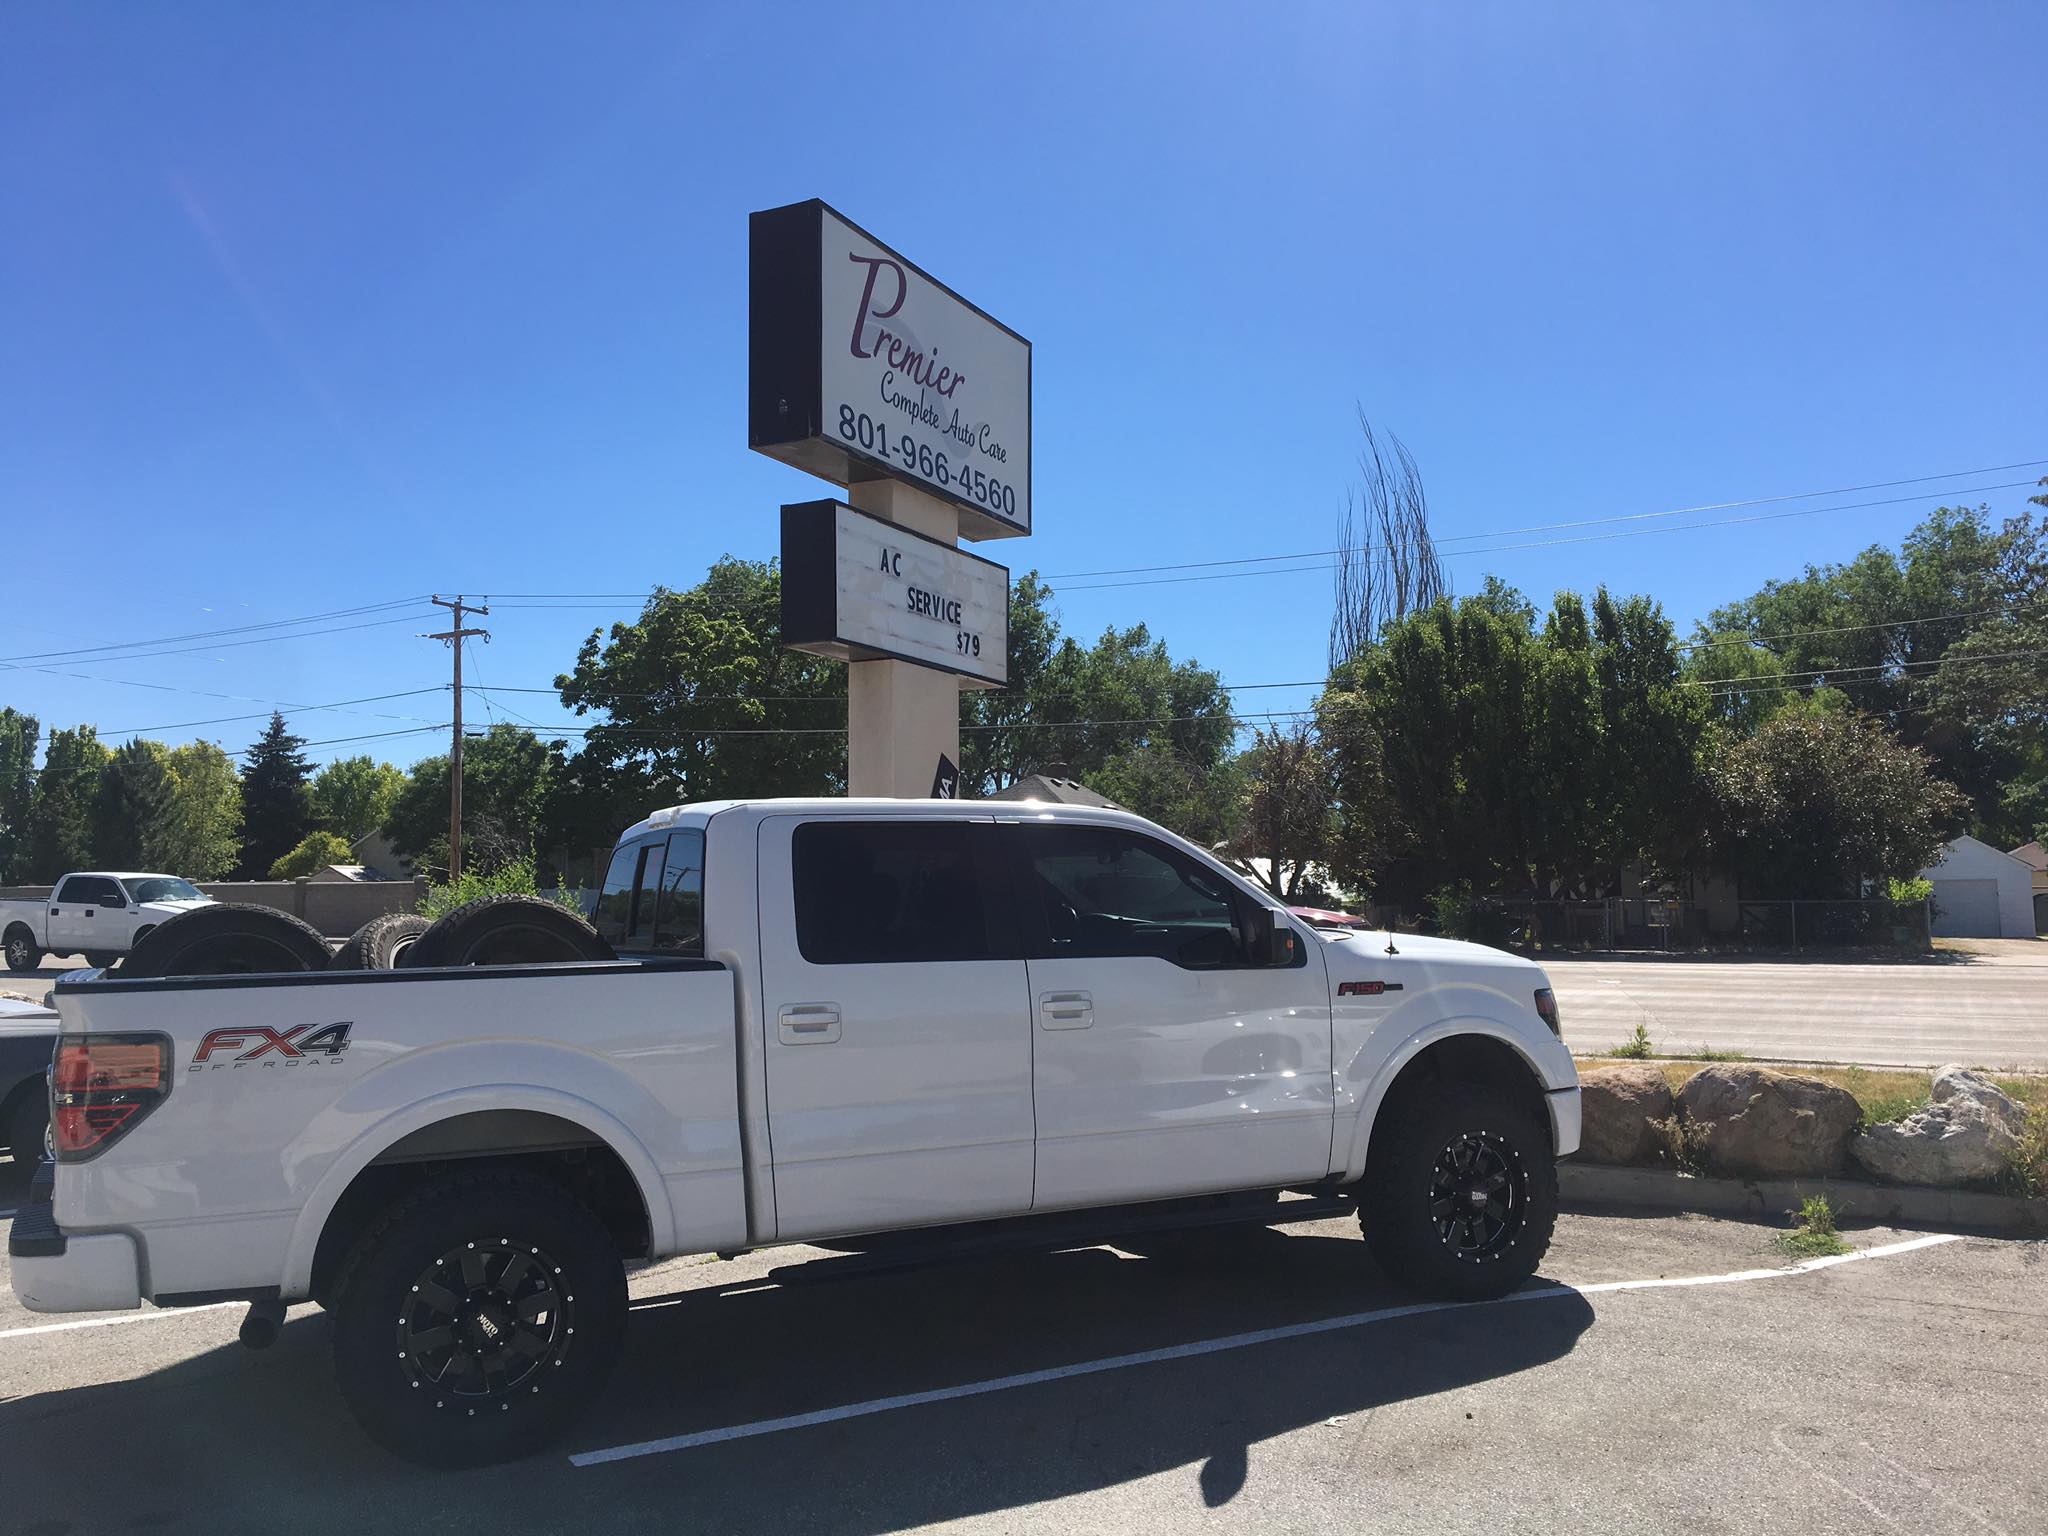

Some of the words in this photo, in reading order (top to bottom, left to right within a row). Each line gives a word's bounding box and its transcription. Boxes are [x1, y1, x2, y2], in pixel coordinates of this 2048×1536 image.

[850, 251, 965, 399] Premier
[880, 371, 939, 428] Complete
[942, 408, 975, 447] Auto
[979, 424, 1006, 463] Care
[839, 403, 1015, 516] 801-966-4560
[907, 586, 961, 625] SERVICE
[957, 631, 980, 657] $79
[192, 1021, 353, 1063] FX4
[188, 1062, 247, 1072] OFF
[262, 1057, 344, 1068] ROAD
